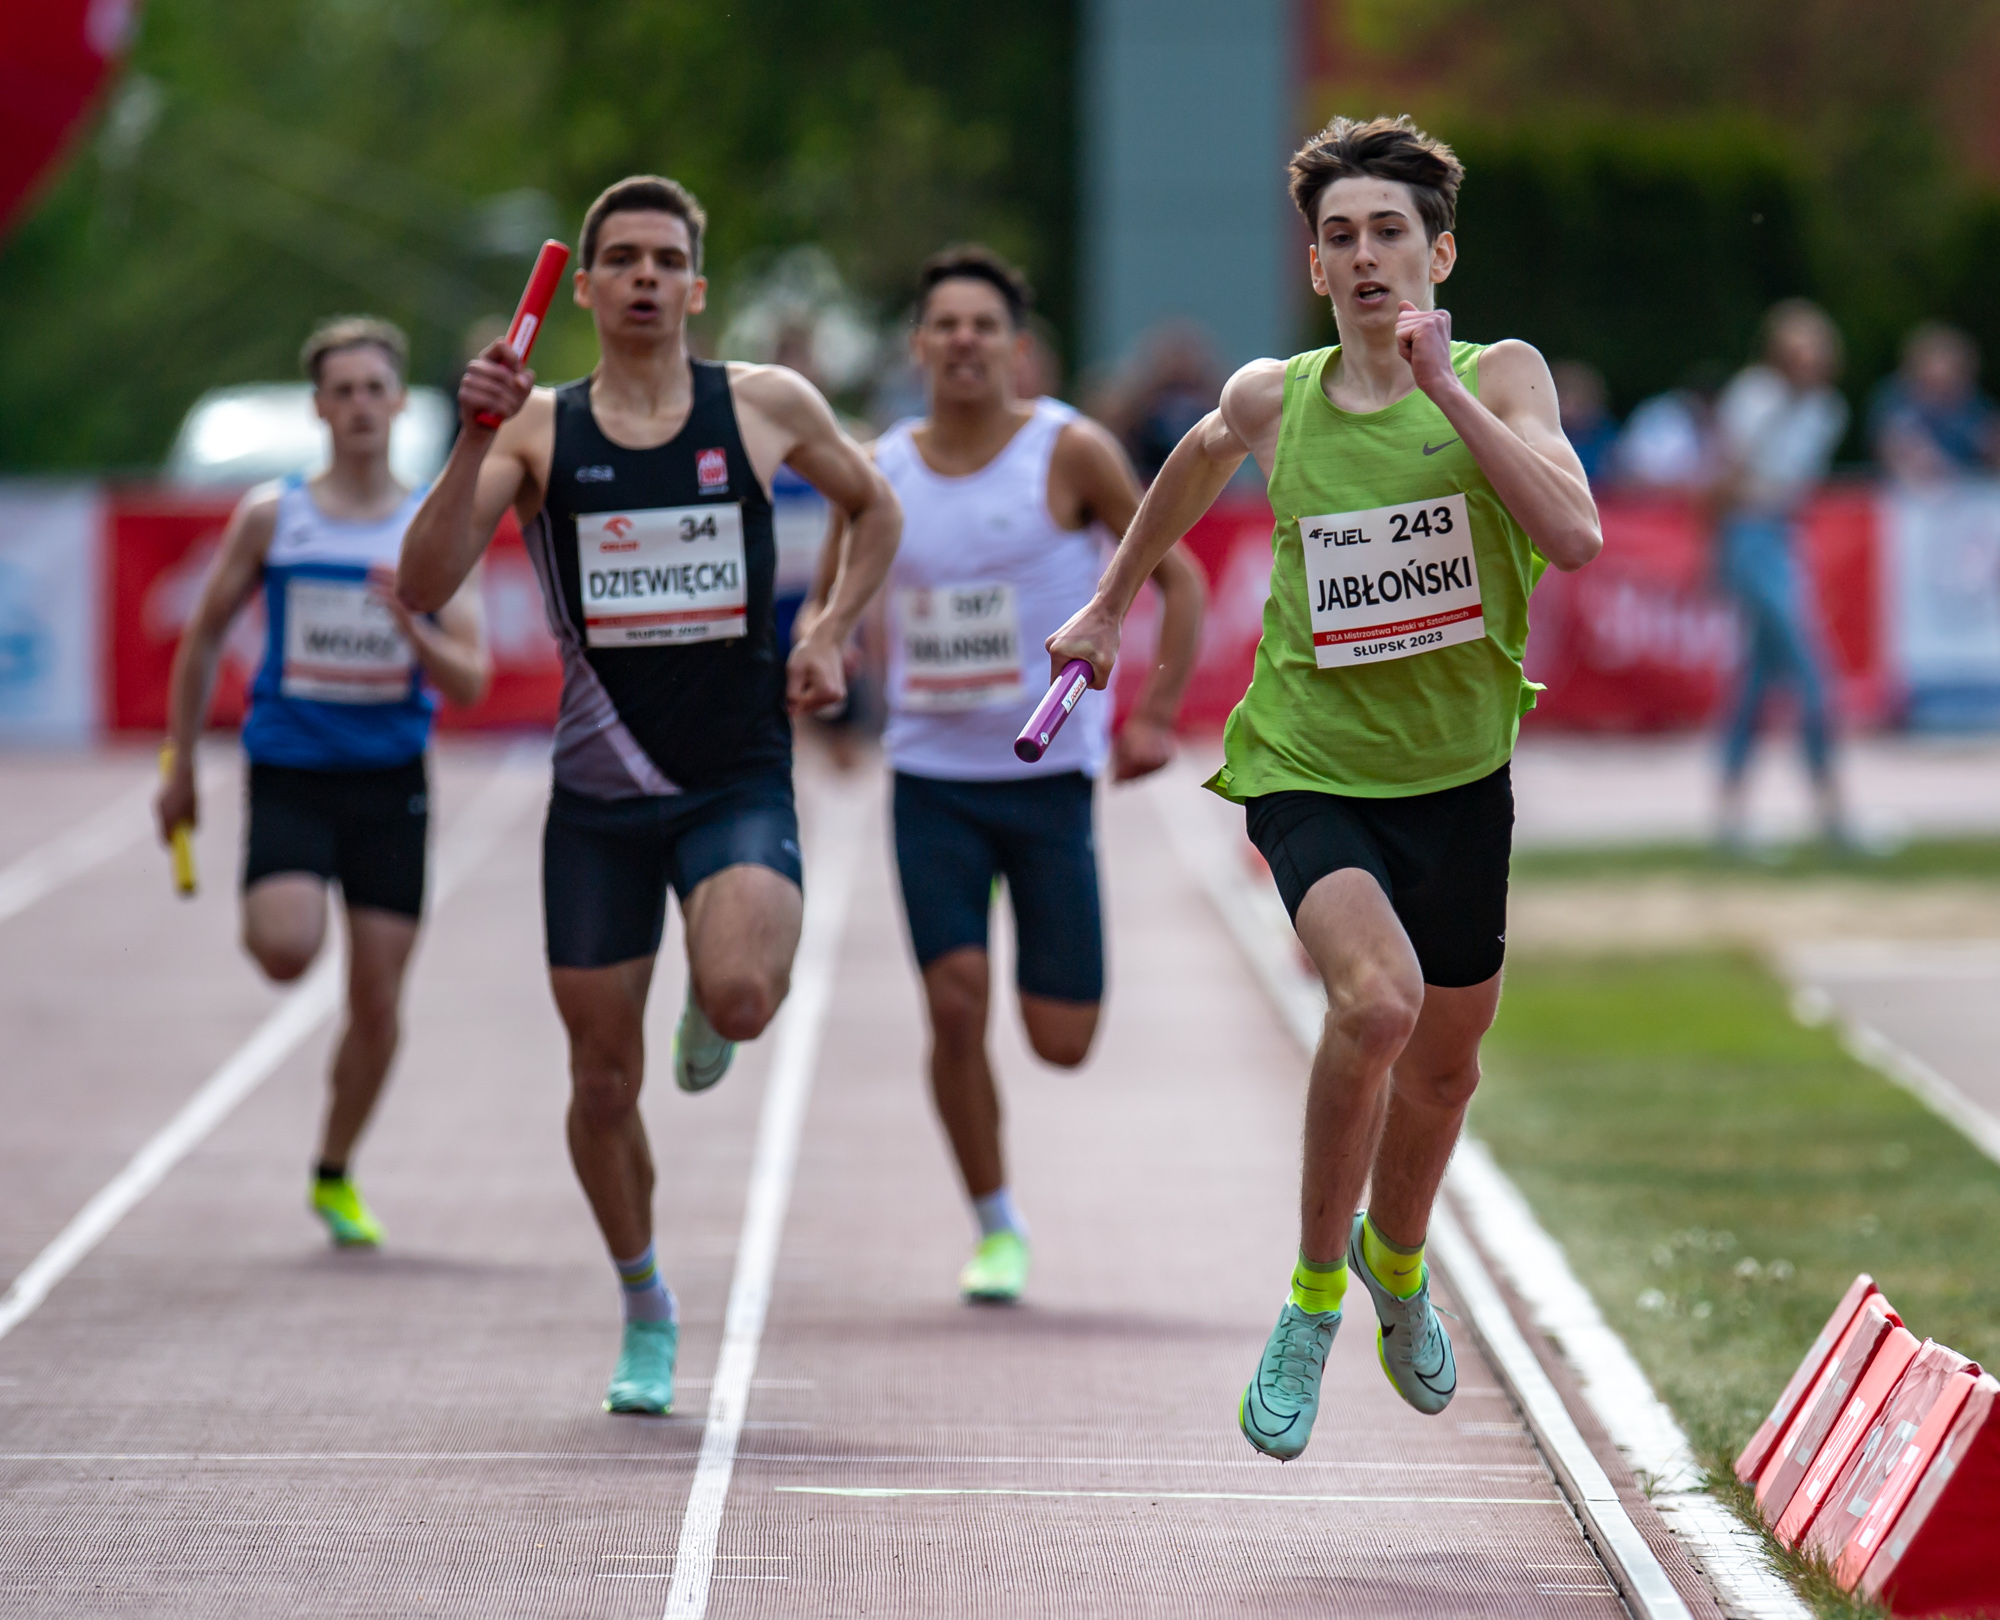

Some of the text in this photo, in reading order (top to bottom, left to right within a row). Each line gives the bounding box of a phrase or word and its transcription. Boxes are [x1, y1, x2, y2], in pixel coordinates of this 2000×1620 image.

[679, 514, 718, 542] 34
[1323, 529, 1371, 548] FUEL
[1389, 506, 1453, 543] 243
[589, 560, 739, 599] DZIEWIĘCKI
[1317, 556, 1472, 612] JABŁOŃSKI
[1326, 610, 1469, 642] PZLA Mistrzostwa Polski w Sztafetach
[1353, 631, 1443, 657] SŁUPSK 2023
